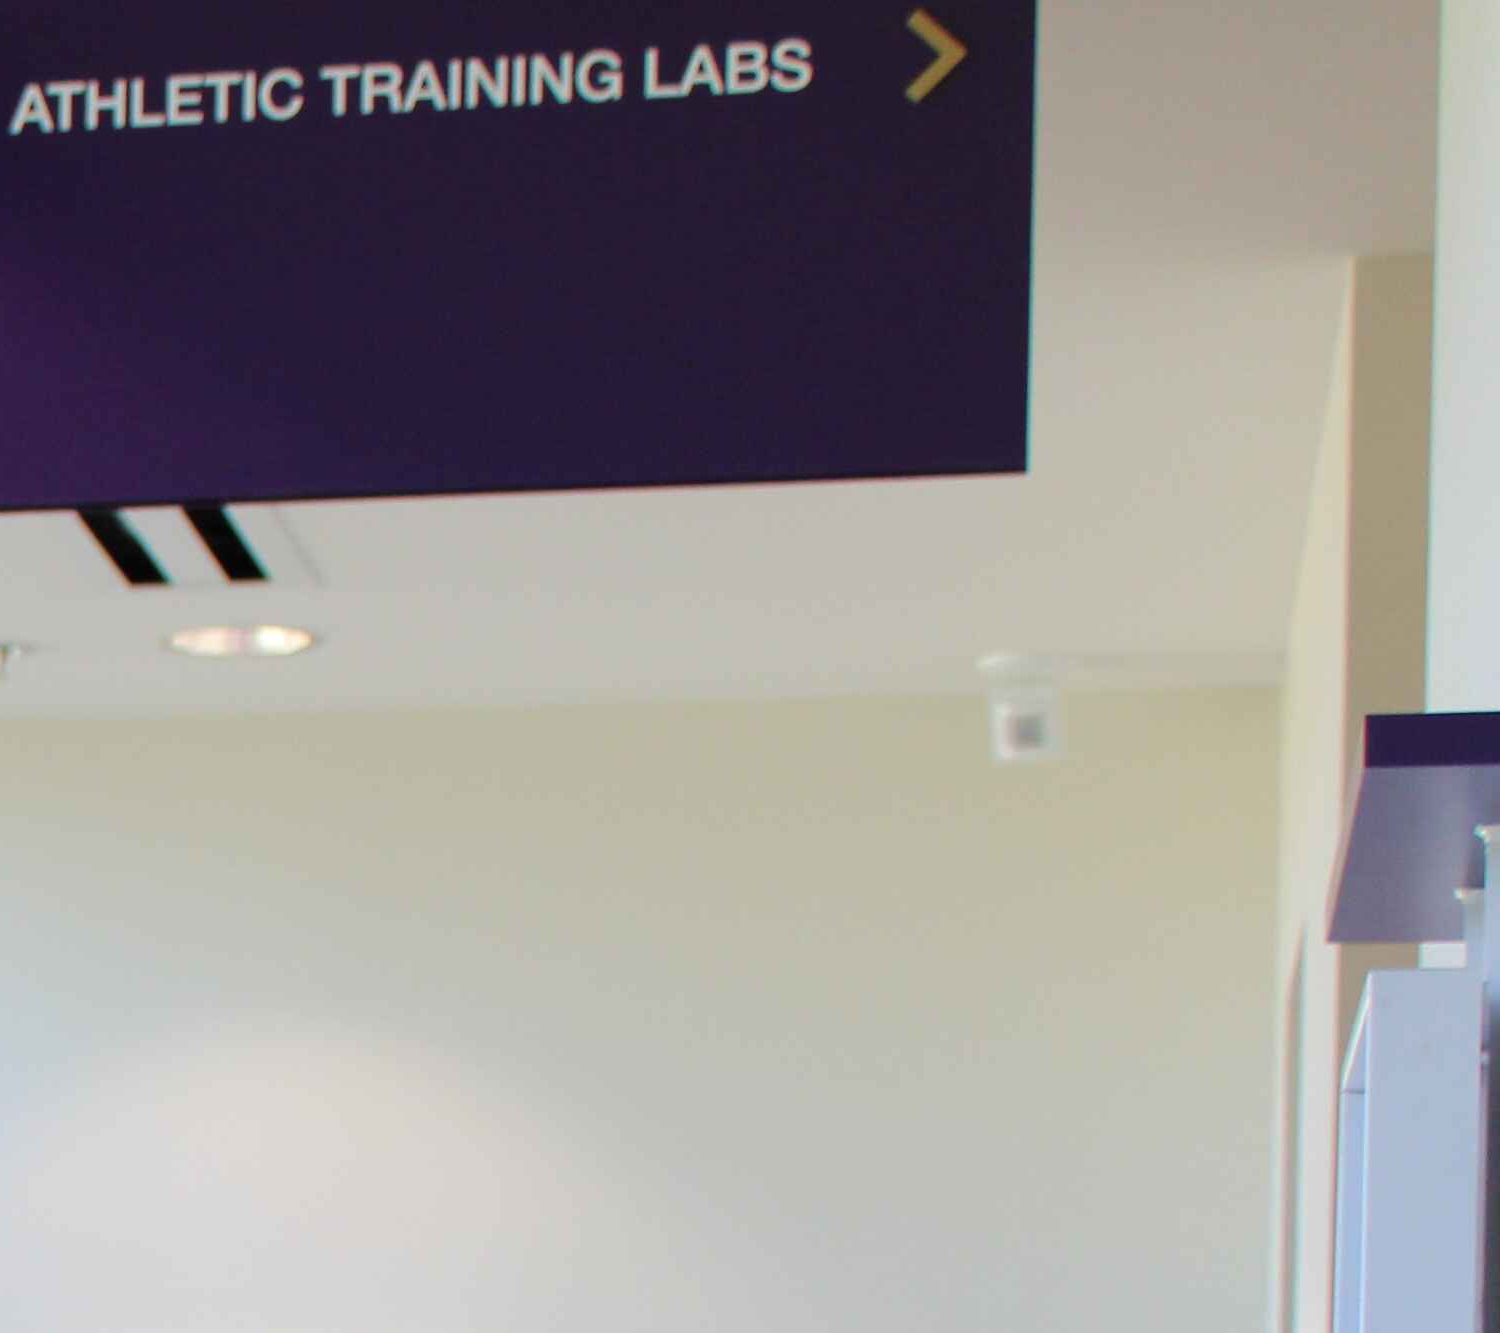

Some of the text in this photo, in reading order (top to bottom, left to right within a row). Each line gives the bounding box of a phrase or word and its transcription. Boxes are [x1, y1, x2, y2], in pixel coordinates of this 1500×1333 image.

[7, 37, 815, 137] ATHLETIC TRAINING LABS
